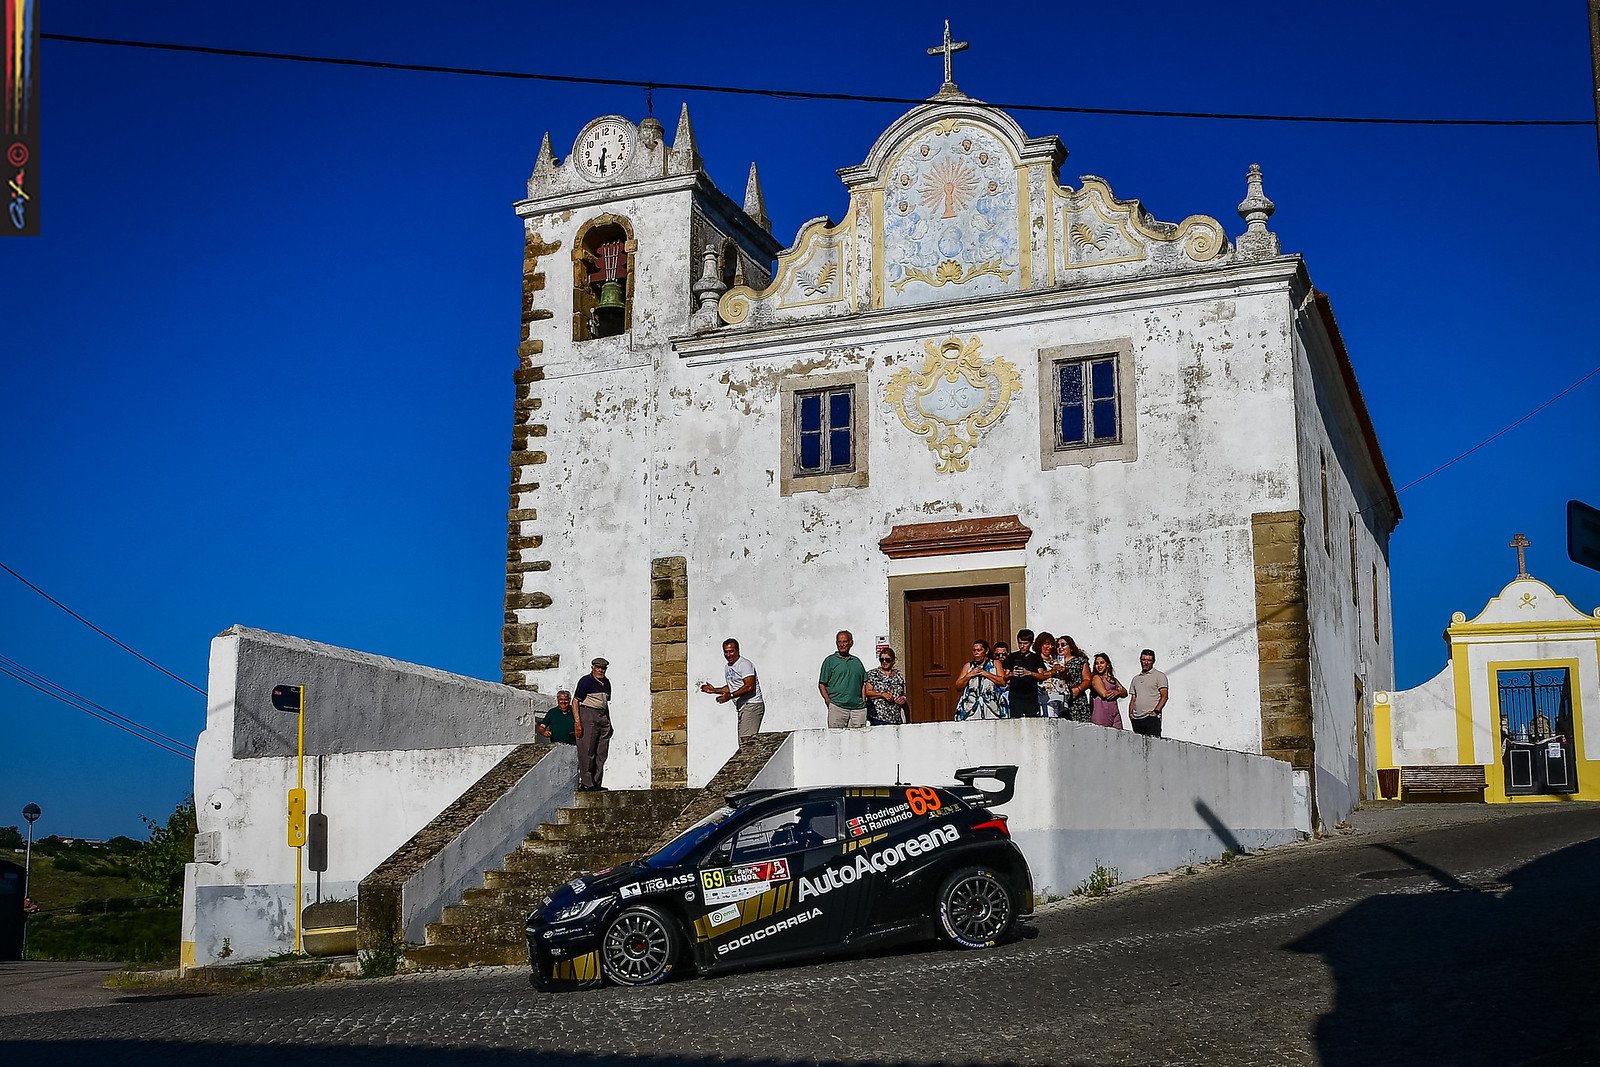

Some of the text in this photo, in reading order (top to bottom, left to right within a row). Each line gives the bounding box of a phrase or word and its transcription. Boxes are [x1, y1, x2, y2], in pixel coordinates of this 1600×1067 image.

[602, 128, 609, 136] 12
[618, 134, 623, 142] 2
[586, 140, 594, 149] 10
[620, 143, 626, 151] 3
[585, 150, 590, 159] 9
[611, 161, 617, 169] 5
[905, 786, 942, 815] 69
[856, 802, 910, 825] R.Rodrigues
[869, 811, 913, 831] Raimundo
[798, 824, 961, 903] AutoAçoreana
[703, 870, 723, 889] 69
[717, 907, 824, 955] SOCICORREIA
